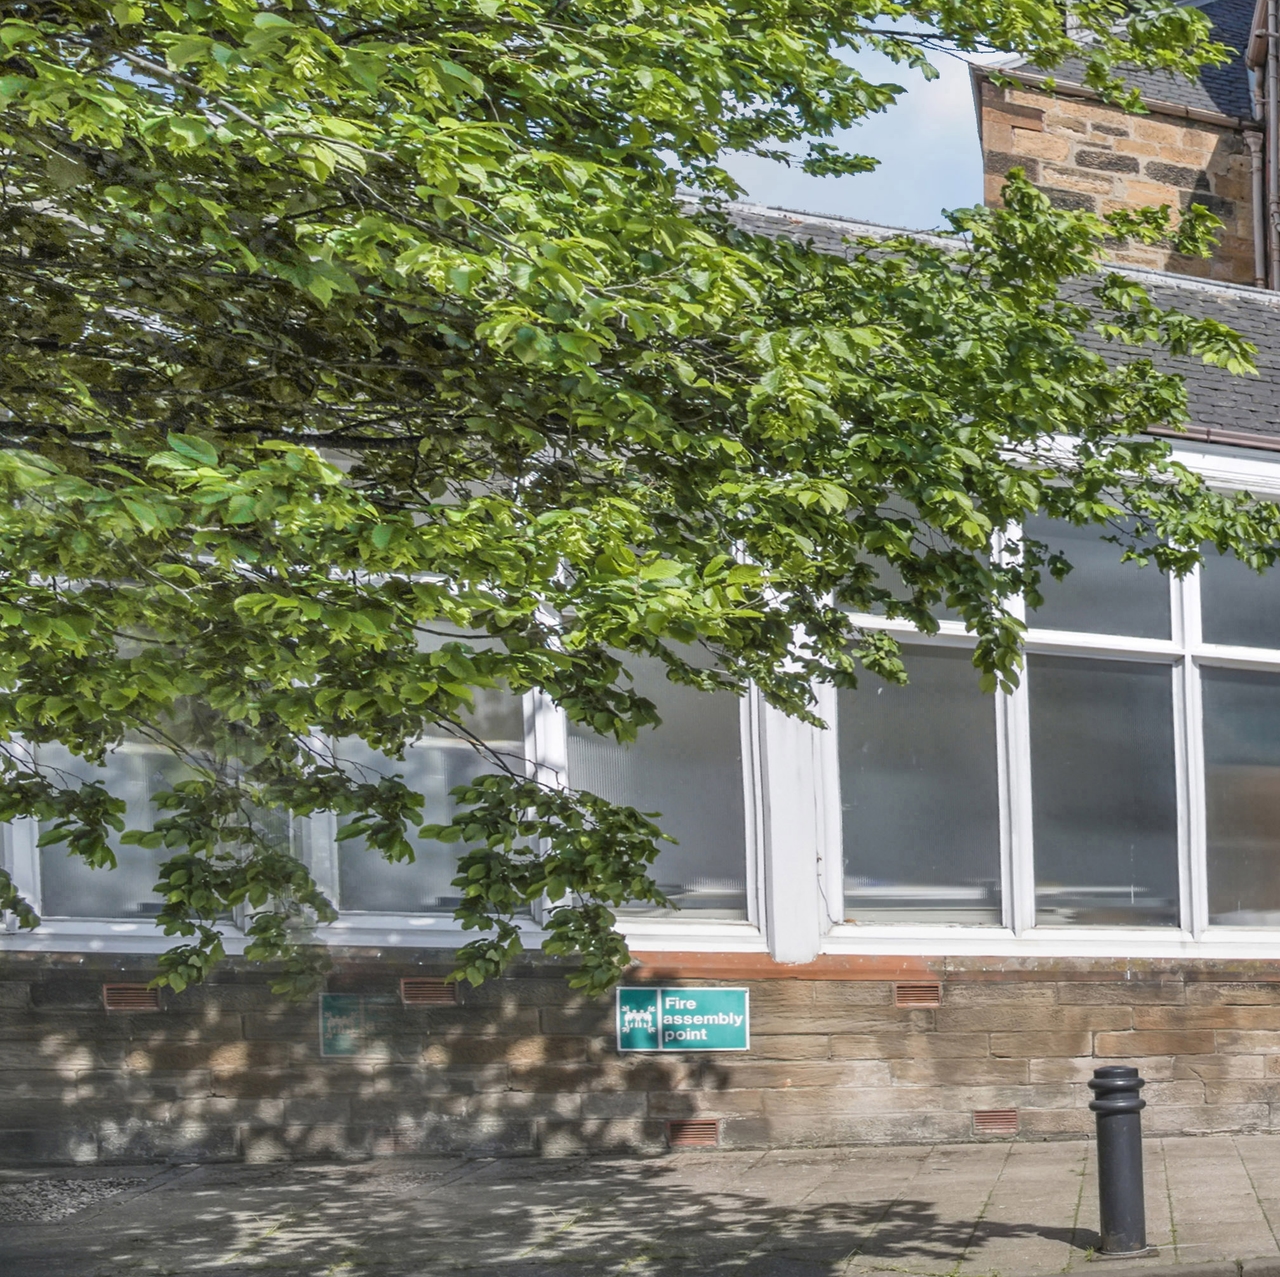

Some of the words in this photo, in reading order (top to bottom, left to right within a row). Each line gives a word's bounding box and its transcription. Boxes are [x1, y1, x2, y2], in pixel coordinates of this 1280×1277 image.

[664, 997, 697, 1010] Fire
[663, 1012, 744, 1027] assembly
[664, 1028, 707, 1042] point
